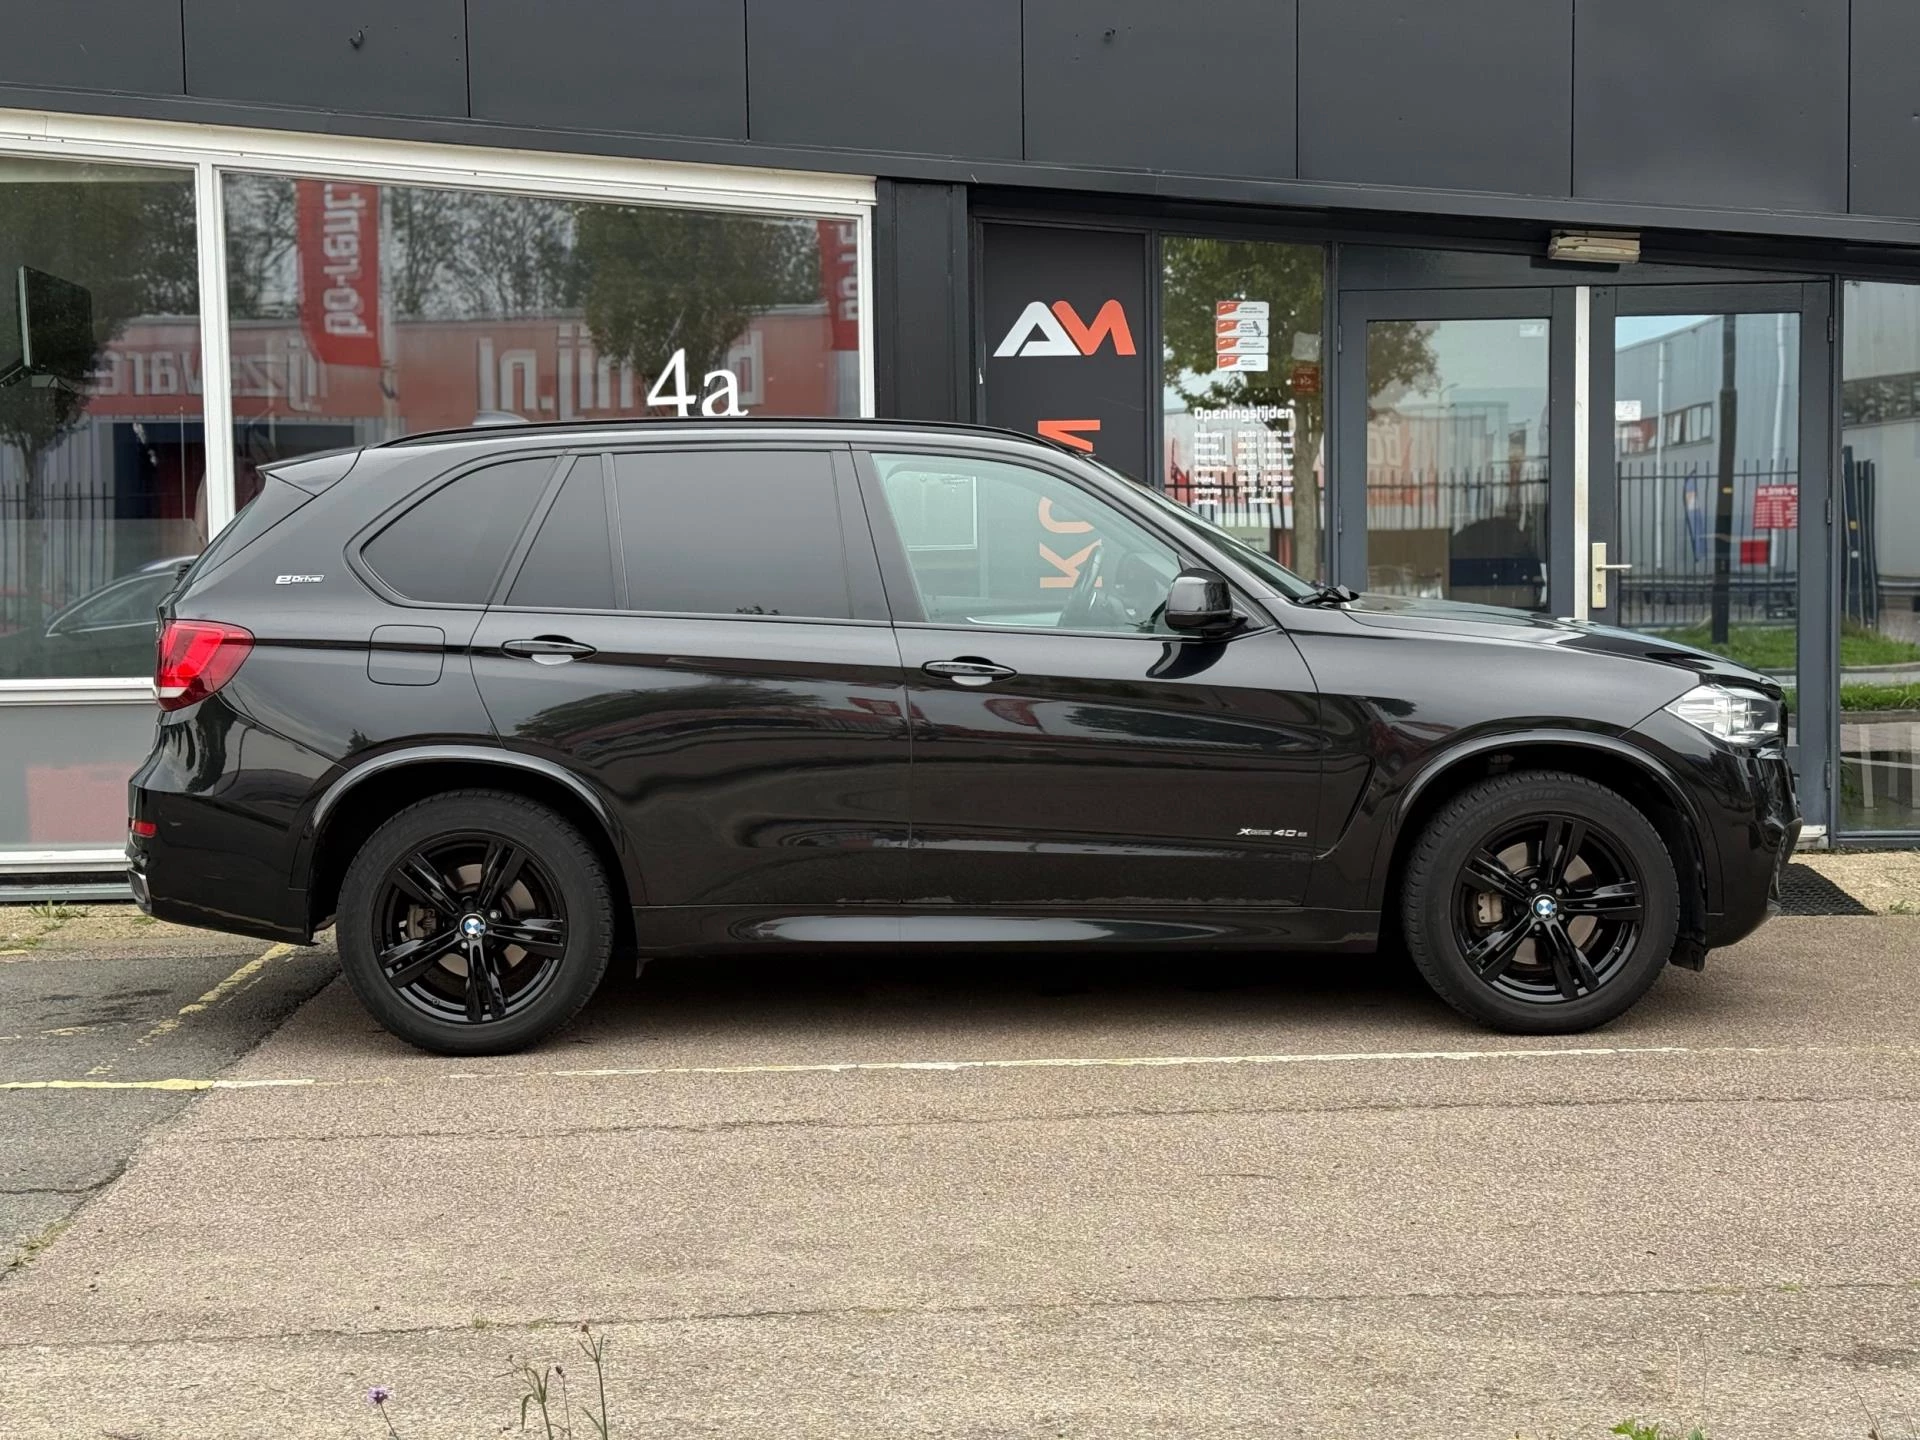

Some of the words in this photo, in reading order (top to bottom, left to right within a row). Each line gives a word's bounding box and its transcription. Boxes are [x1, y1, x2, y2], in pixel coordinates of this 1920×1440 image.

[993, 299, 1137, 357] AM
[646, 348, 749, 418] 4a
[1194, 405, 1294, 422] Openingstijden
